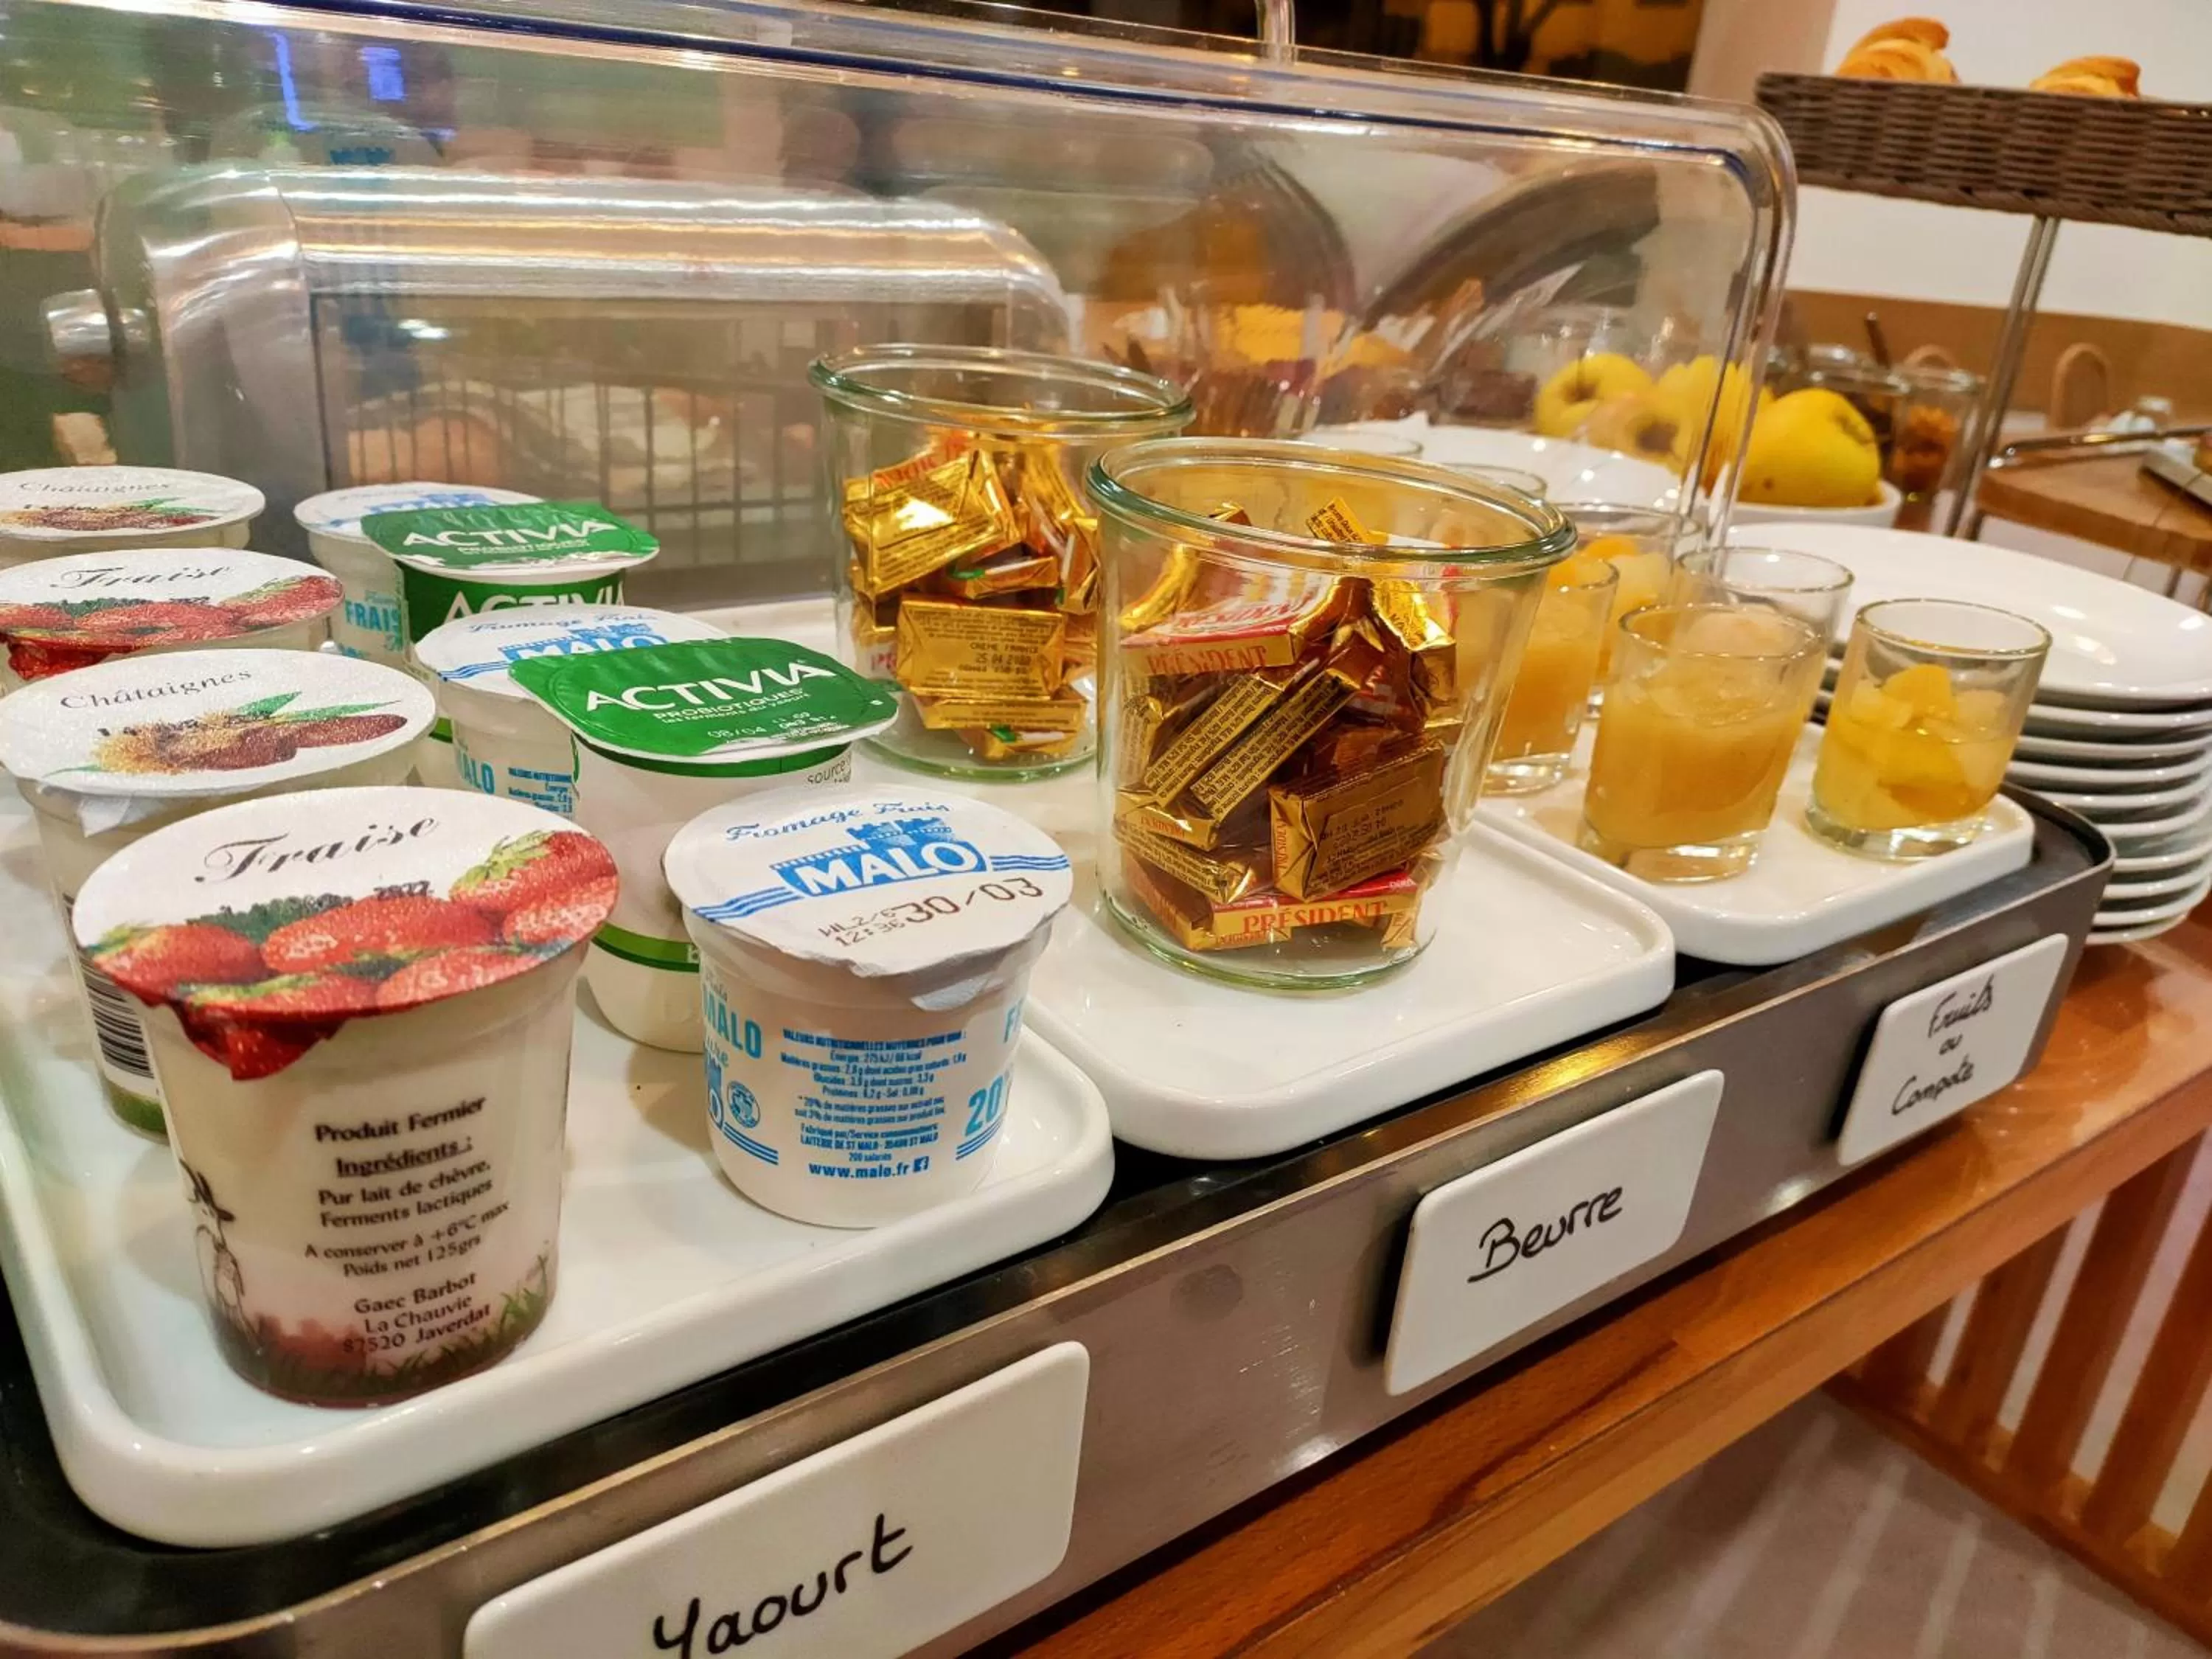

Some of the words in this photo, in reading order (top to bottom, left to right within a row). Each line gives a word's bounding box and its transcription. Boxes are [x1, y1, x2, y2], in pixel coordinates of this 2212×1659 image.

[403, 518, 619, 548] ACTIVIA
[587, 659, 837, 712] ACTIVIA
[726, 808, 863, 841] Fromage
[194, 816, 440, 885] Fraise
[797, 841, 980, 895] MALO
[891, 877, 1044, 923] 30/03
[1242, 900, 1388, 934] PRÉSIDENT
[315, 1119, 400, 1144] Produit
[407, 1096, 487, 1133] Fermier
[335, 1140, 459, 1179] Ingrédients
[807, 1161, 910, 1179] www.malo.fr
[318, 1189, 353, 1208] Pur
[361, 1185, 392, 1204] lait
[399, 1179, 423, 1198] de
[320, 1206, 410, 1230] Ferments
[417, 1179, 494, 1217] lactiques
[304, 1244, 319, 1259] A
[323, 1236, 409, 1259] conserver
[413, 1232, 424, 1248] à
[480, 1200, 510, 1224] max
[1467, 1186, 1624, 1284] Beurre
[343, 1258, 389, 1278] Poids
[394, 1256, 420, 1272] net
[353, 1293, 406, 1315] Gaec
[413, 1272, 478, 1305] Barbot
[364, 1318, 389, 1335] La
[394, 1294, 473, 1330] Chauvie
[415, 1303, 492, 1345] Javerdat
[652, 1512, 914, 1659] Yaourt
